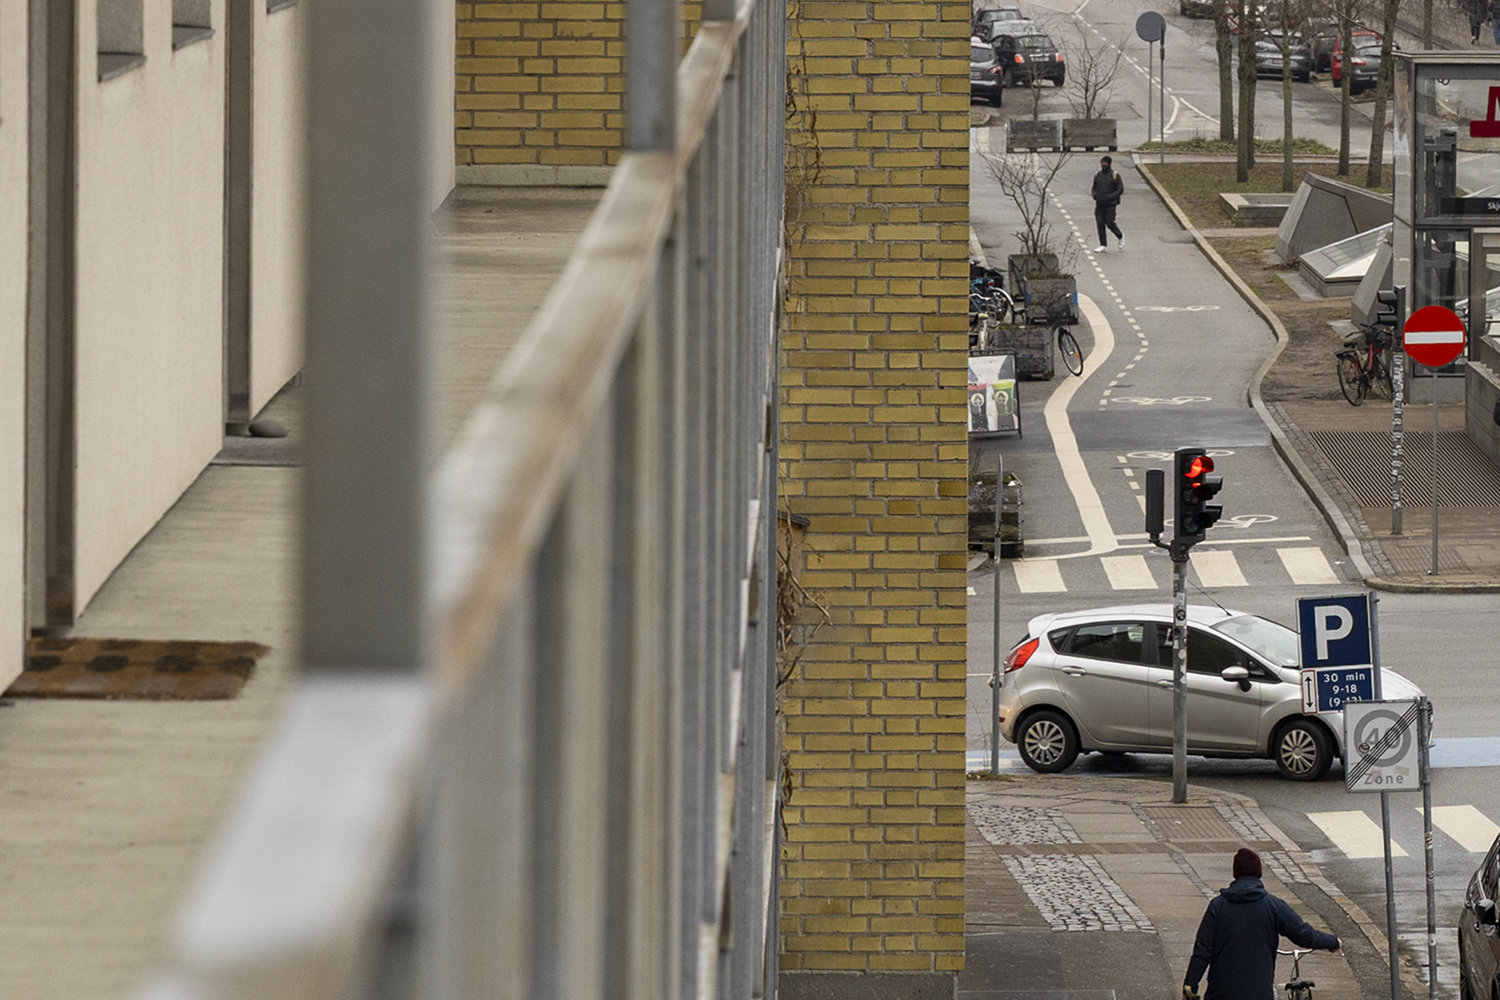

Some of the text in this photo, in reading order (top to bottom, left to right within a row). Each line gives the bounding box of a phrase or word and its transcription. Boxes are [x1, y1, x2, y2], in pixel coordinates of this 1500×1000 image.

[1314, 605, 1354, 660] P
[1324, 672, 1366, 683] 30 min
[1332, 684, 1357, 694] 9-18
[1365, 728, 1401, 749] 40
[1364, 773, 1403, 784] Zone
